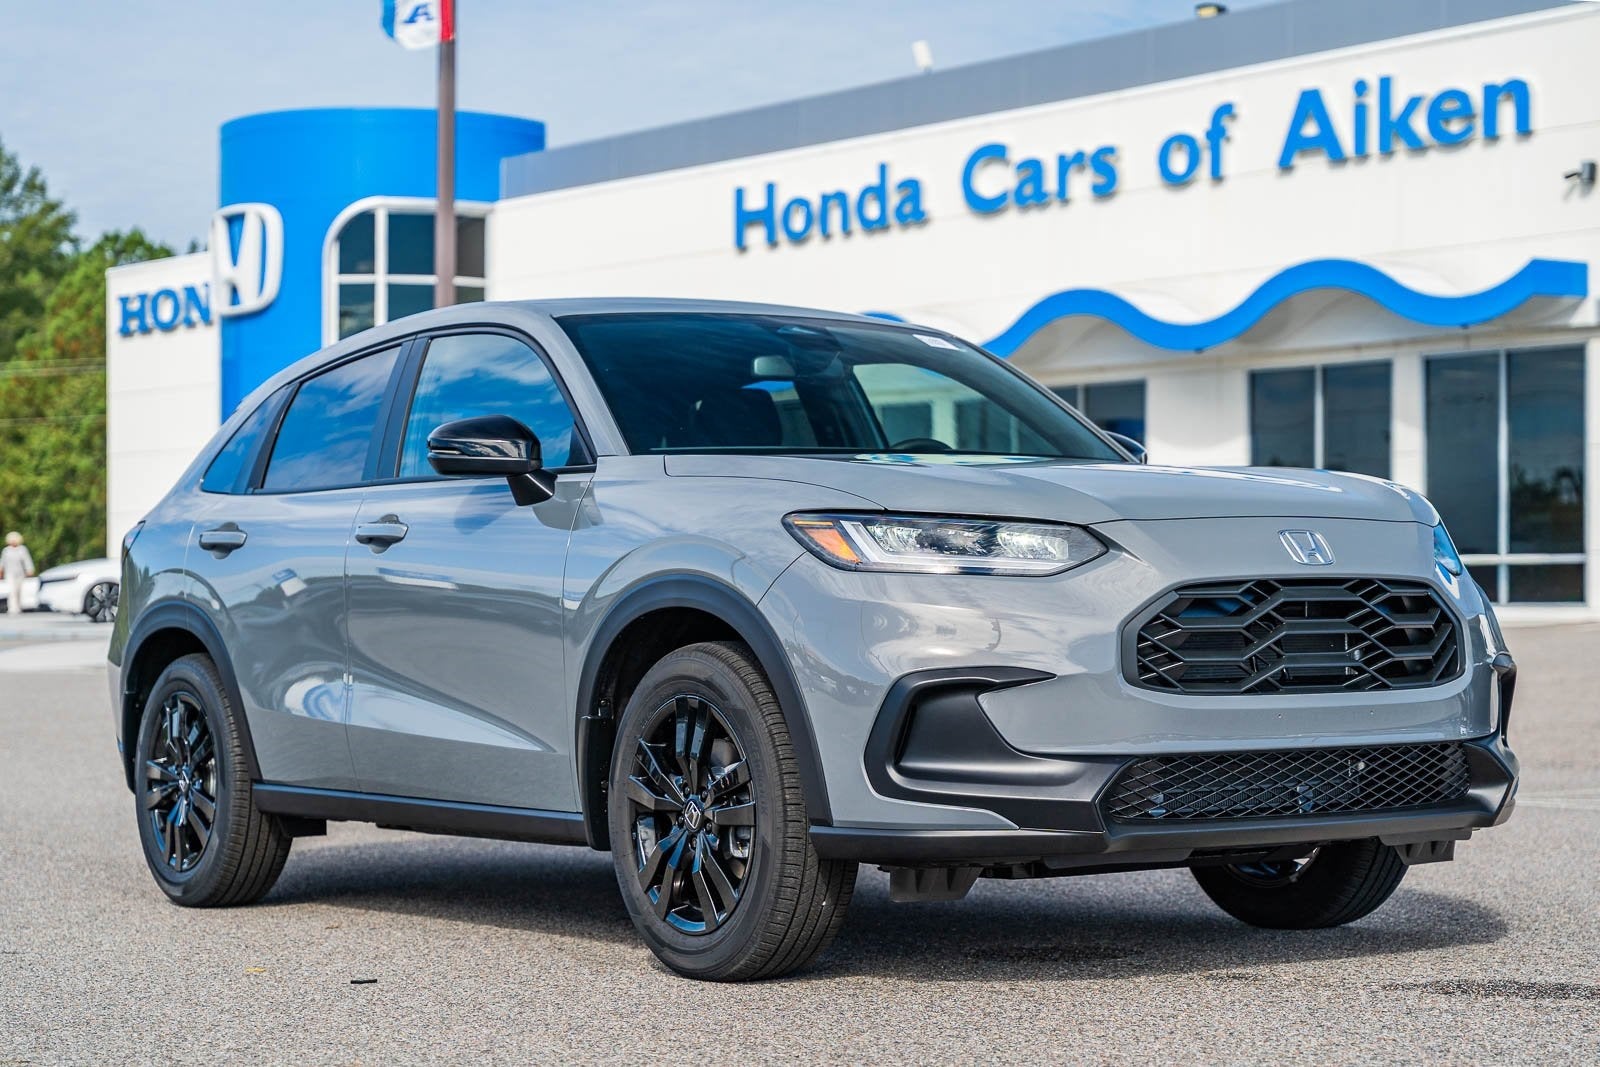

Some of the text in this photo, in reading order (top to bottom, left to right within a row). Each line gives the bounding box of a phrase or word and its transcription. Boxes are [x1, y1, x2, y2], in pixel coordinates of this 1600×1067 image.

[734, 75, 1532, 249] Honda Cars of Aiken
